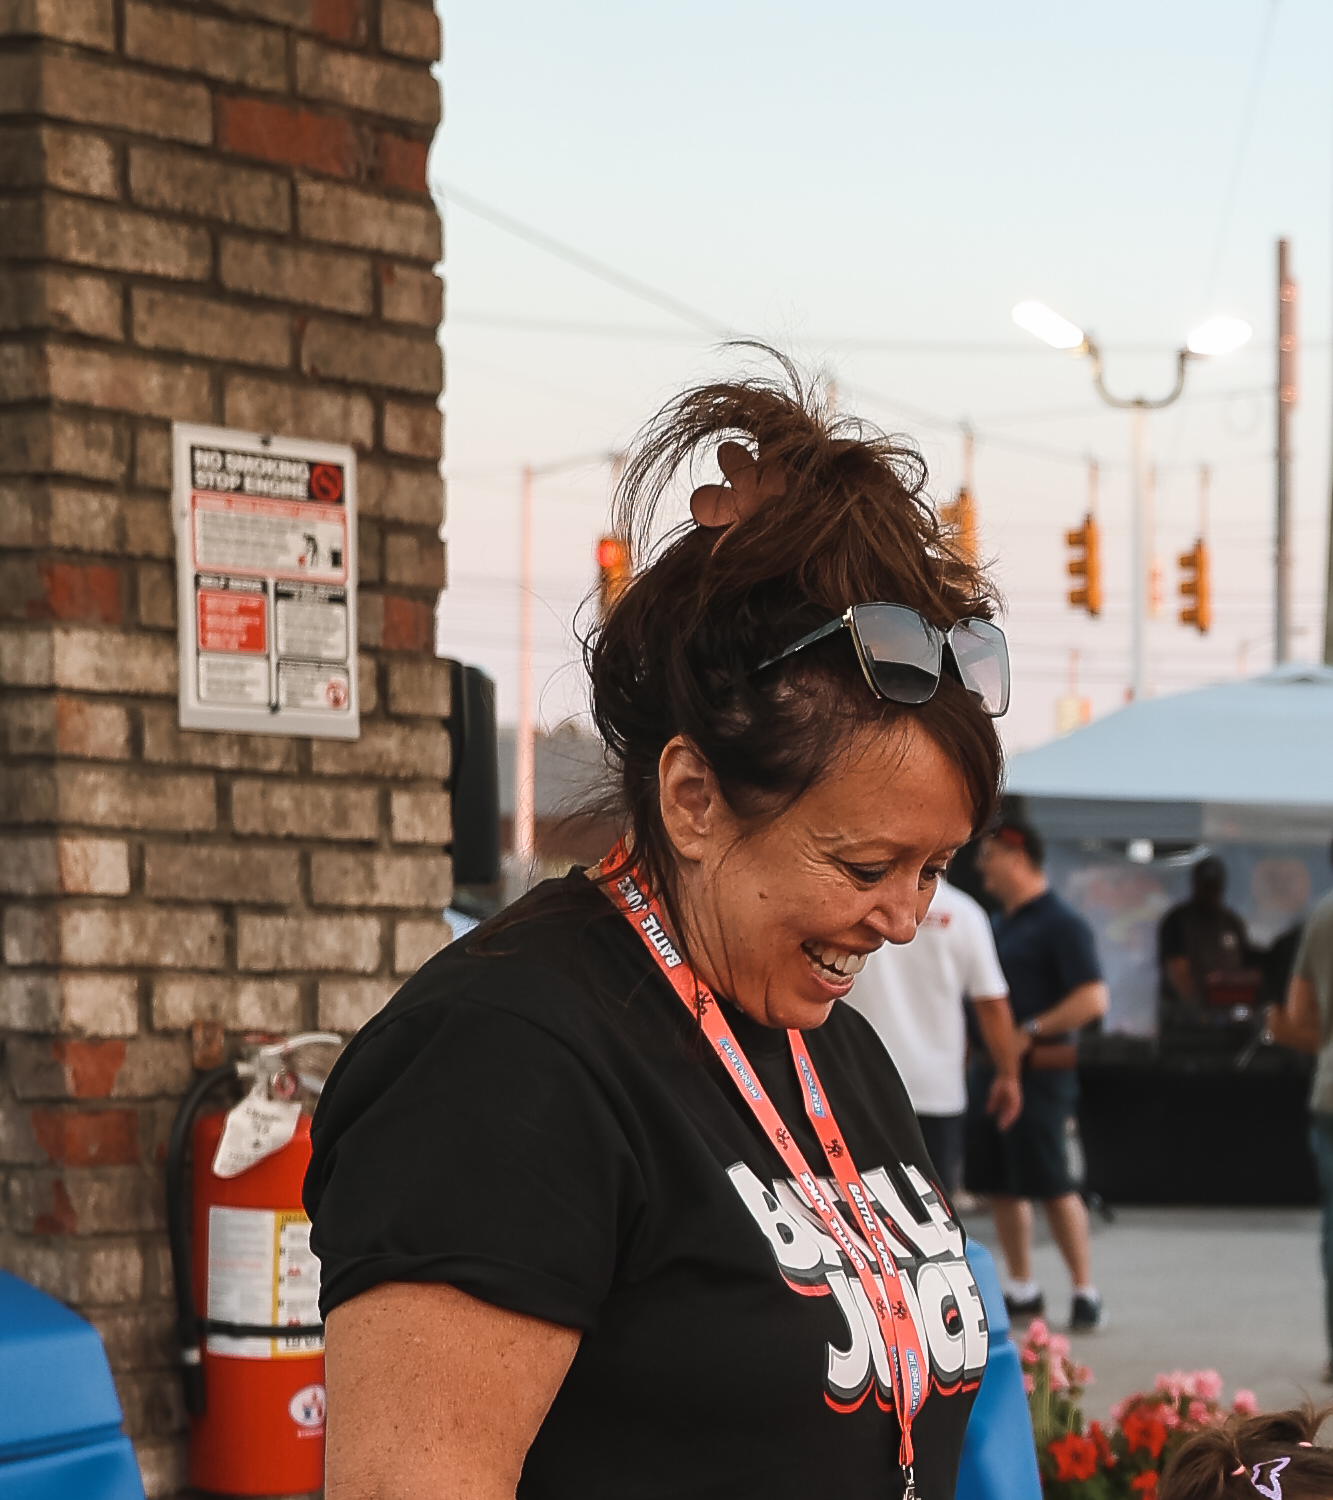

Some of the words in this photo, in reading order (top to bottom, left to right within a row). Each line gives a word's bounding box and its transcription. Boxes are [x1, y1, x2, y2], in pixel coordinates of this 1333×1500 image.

[641, 913, 683, 969] BATTLE
[801, 1171, 830, 1214] JUICE
[829, 1217, 865, 1270] BATTLE
[848, 1183, 876, 1233] BATTLE
[872, 1232, 896, 1278] JUICE
